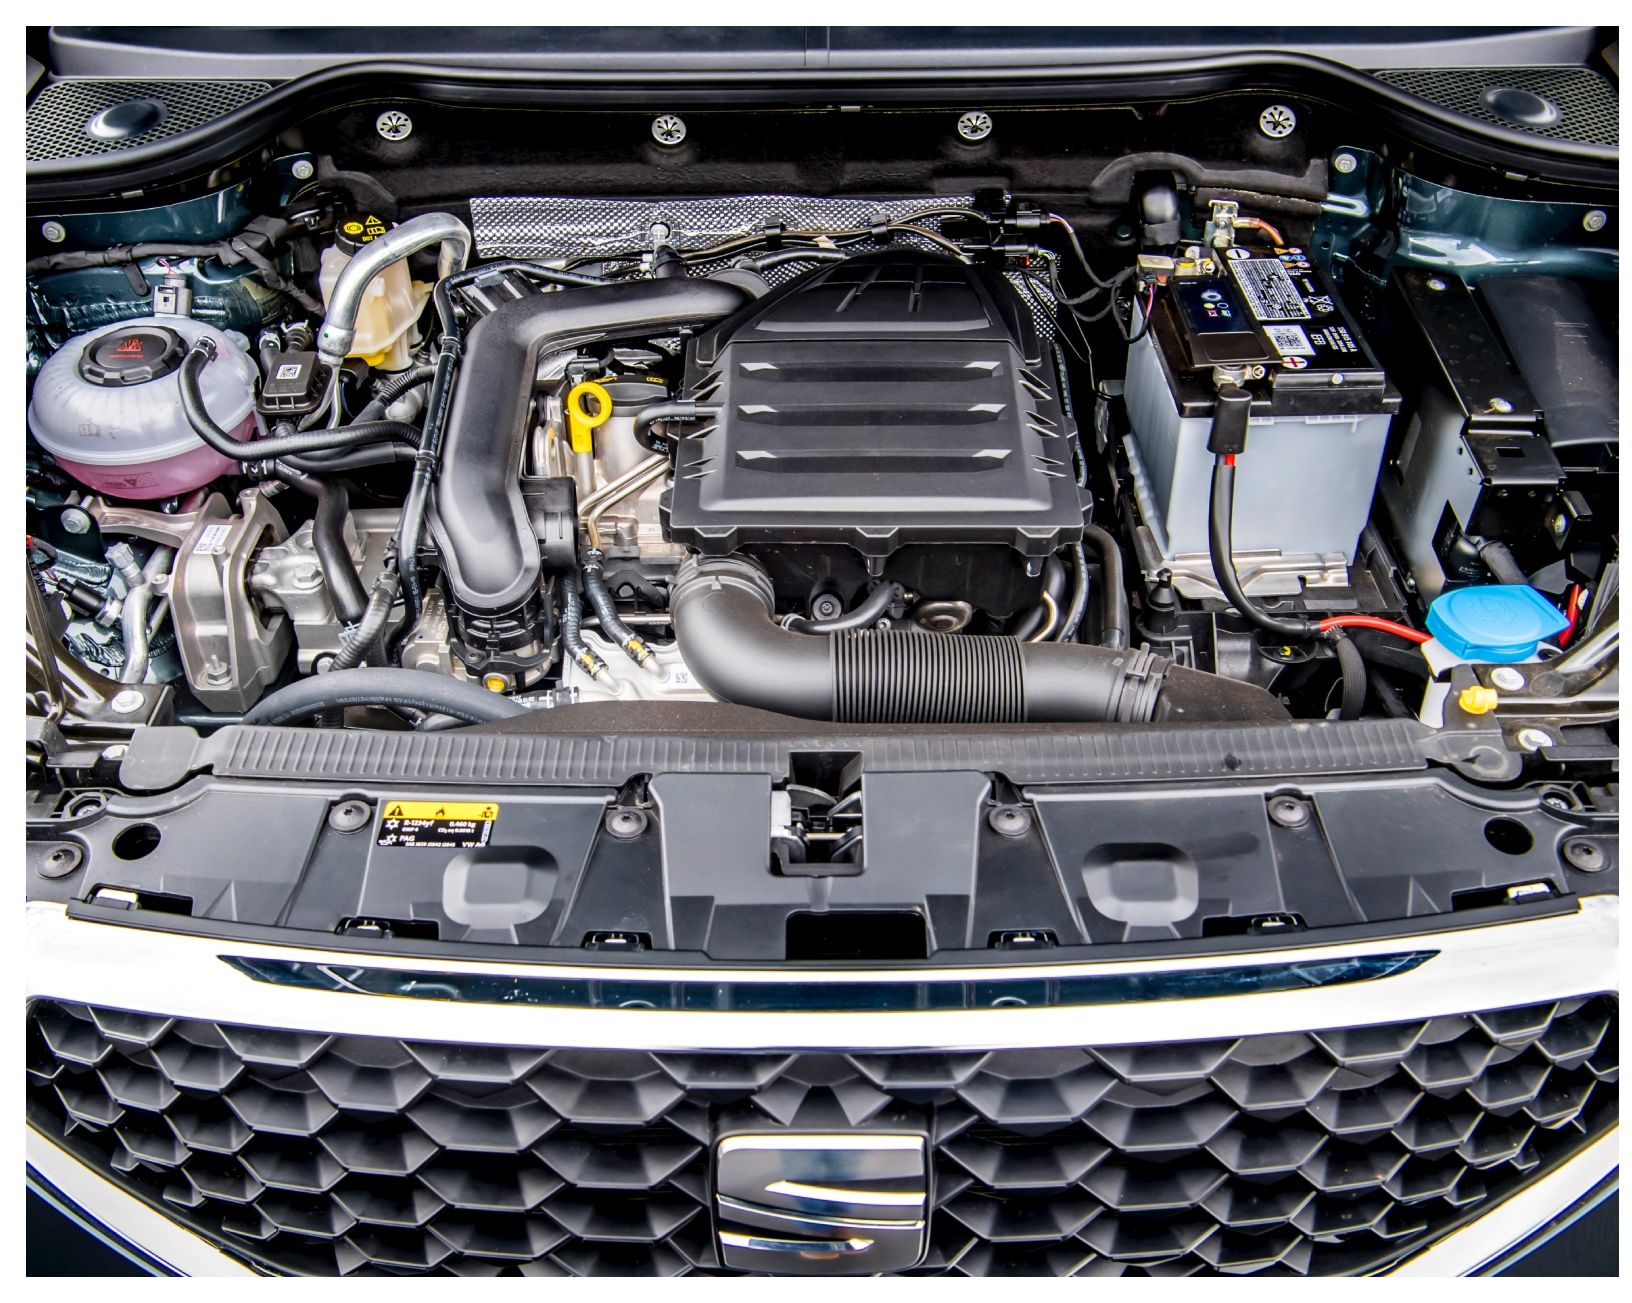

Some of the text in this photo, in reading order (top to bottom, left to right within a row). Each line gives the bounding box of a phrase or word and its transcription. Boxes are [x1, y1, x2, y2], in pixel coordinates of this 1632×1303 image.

[1310, 333, 1327, 345] EFB
[467, 821, 476, 829] kg
[399, 834, 416, 842] PAG
